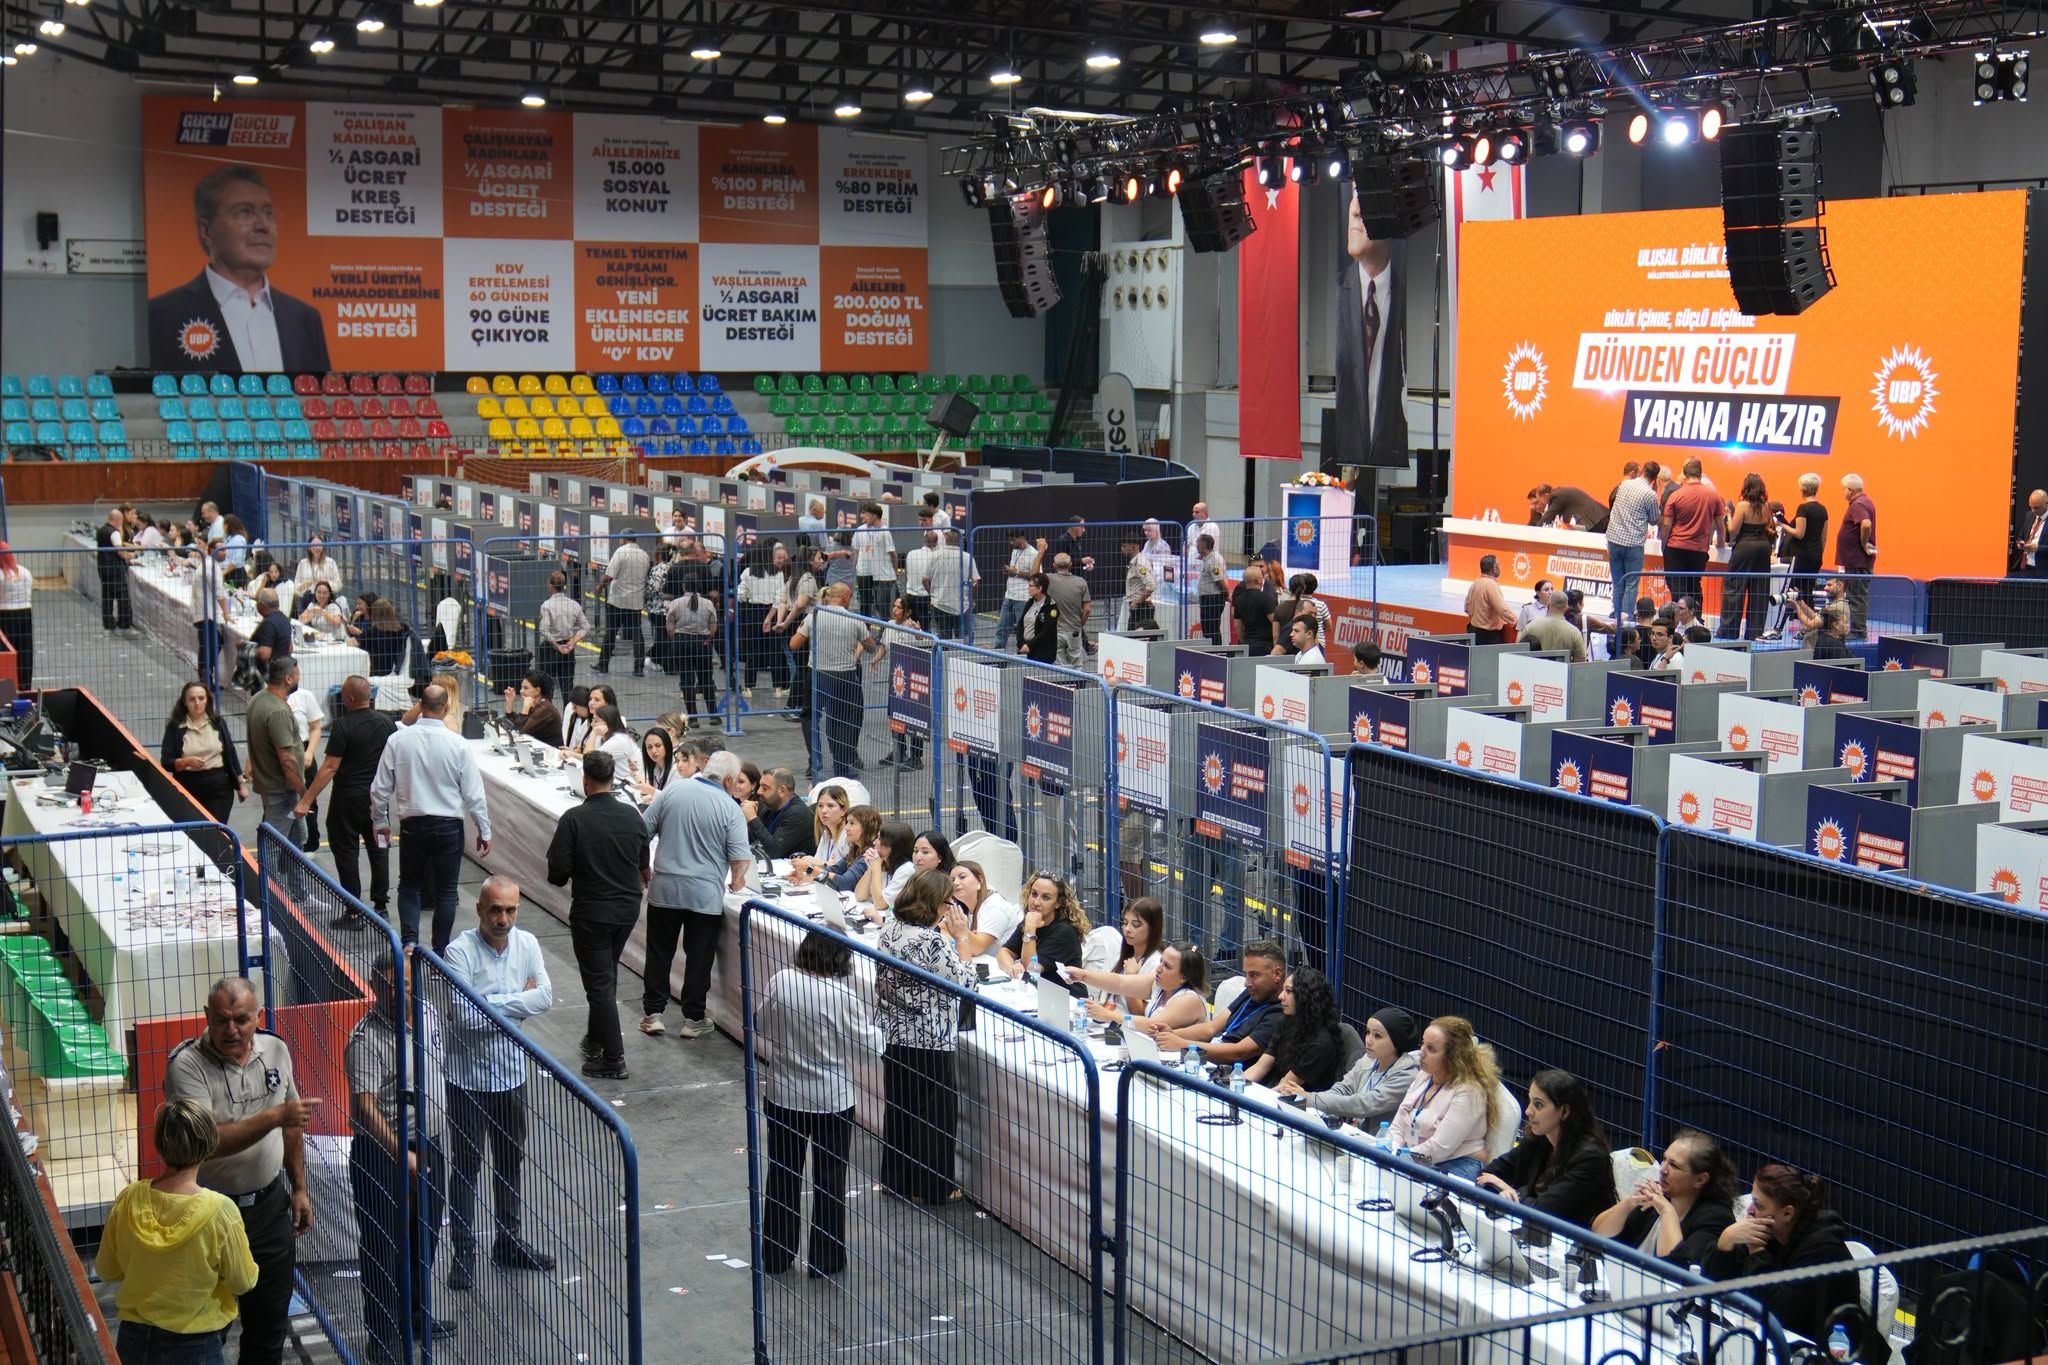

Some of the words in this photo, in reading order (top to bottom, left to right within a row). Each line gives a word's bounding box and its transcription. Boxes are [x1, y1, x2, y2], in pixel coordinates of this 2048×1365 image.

[343, 119, 407, 132] ÇALIŞAN
[179, 128, 212, 144] AİLE
[230, 130, 290, 145] GELECEK
[333, 132, 417, 145] KADINLARA
[348, 147, 421, 166] ASGARİ
[592, 144, 680, 160] AİLELERİMİZE
[344, 165, 407, 185] ÜCRET
[484, 161, 553, 180] ASGARİ
[608, 160, 665, 176] 15.000
[843, 168, 912, 179] ERKEKLERE
[478, 179, 539, 198] ÜCRET
[603, 179, 671, 195] SOSYAL
[711, 176, 757, 192] %100
[761, 175, 806, 193] PRİM
[835, 180, 871, 194] %80
[876, 179, 918, 196] PRİM
[351, 189, 401, 209] KREŞ
[606, 198, 668, 213] KONUT
[723, 193, 796, 211] DESTEĞİ
[843, 196, 912, 214] DESTEĞİ
[336, 206, 416, 224] DESTEĞİ
[470, 199, 548, 218] DESTEĞİ
[585, 248, 628, 259] TEMEL
[631, 246, 688, 259] TÜKETİM
[1637, 248, 1678, 267] ULUSAL
[1680, 242, 1720, 266] BİRLİK
[495, 263, 523, 274] KDV
[607, 263, 667, 273] KAPSAMI
[331, 272, 368, 284] YERLİ
[371, 271, 421, 285] ÜRETİM
[469, 275, 550, 288] ERTELEMESİ
[596, 274, 678, 288] GENİŞLİYOR.
[712, 276, 808, 289] YAŞLILARIMIZA
[850, 280, 906, 292] AİLELERE
[312, 286, 440, 299] HAMMADDELERİNE
[470, 291, 486, 302] 60
[491, 288, 549, 302] GÜNDEN
[616, 287, 658, 304] YENİ
[737, 287, 799, 304] ASGARİ
[337, 303, 417, 317] NAVLUN
[834, 295, 900, 309] 200.000
[904, 296, 923, 310] TL
[469, 309, 492, 323] 90
[498, 305, 550, 323] GÜNE
[585, 309, 689, 324] EKLENECEK
[703, 304, 757, 322] ÜCRET
[762, 309, 817, 322] BAKIM
[846, 310, 911, 327] DOĞUM
[1604, 308, 1636, 328] BİRLİK
[1637, 308, 1672, 332] İÇİNDE,
[1674, 307, 1710, 332] GÜÇLÜ
[1710, 307, 1756, 332] BİÇİMDE
[337, 319, 417, 337] DESTEĞİ
[591, 324, 684, 342] ÜRÜNLERE
[726, 323, 795, 340] DESTEĞİ
[189, 333, 210, 345] UBP
[471, 328, 549, 346] ÇIKIYOR
[844, 329, 913, 345] DESTEĞİ
[636, 346, 674, 361] KDV
[1583, 337, 1685, 383] DÜNDEN
[1691, 338, 1783, 389] GÜÇLÜ
[1514, 371, 1537, 391] UBP
[1888, 380, 1922, 405] UBP
[1633, 398, 1730, 441] YARINA
[1736, 402, 1826, 447] HAZIR
[1550, 557, 1583, 576] DÜNDEN
[1584, 561, 1610, 580] GÜÇLÜ
[1566, 579, 1596, 597] YARINA
[1597, 582, 1614, 598] HAZ
[1386, 628, 1413, 656] GÜÇ
[1732, 733, 1745, 745] UBP
[1848, 755, 1860, 766] UBP
[1976, 779, 1994, 793] UBP
[2012, 788, 2027, 799] ADAY
[1682, 801, 1697, 815] UBP
[1823, 836, 1839, 851] UBP
[1996, 880, 2017, 897] UBP
